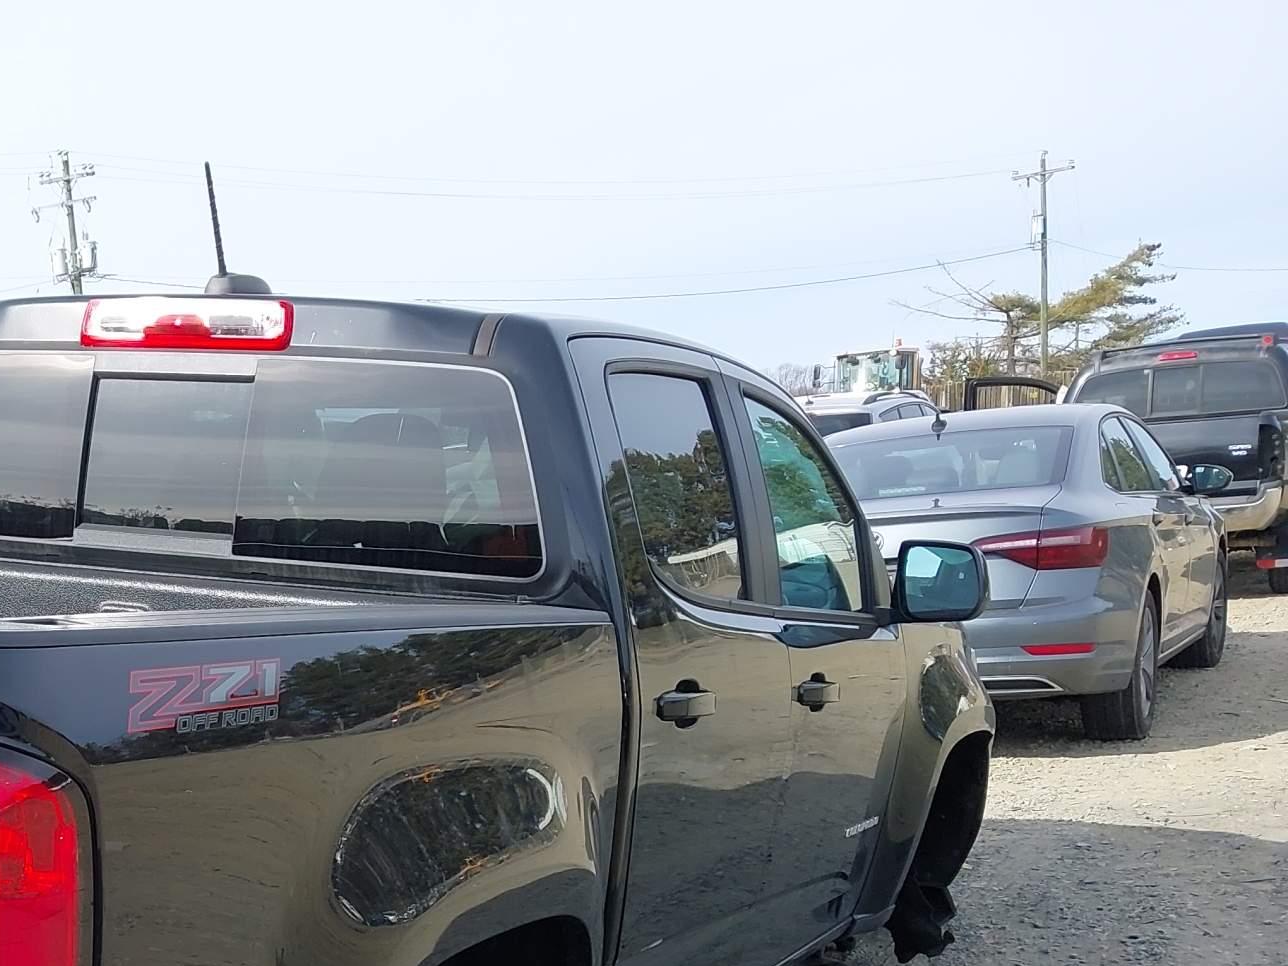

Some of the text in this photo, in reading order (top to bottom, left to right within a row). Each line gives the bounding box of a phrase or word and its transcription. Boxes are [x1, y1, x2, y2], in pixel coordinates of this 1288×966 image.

[127, 657, 281, 734] Z71
[176, 703, 280, 735] OFF ROAD
